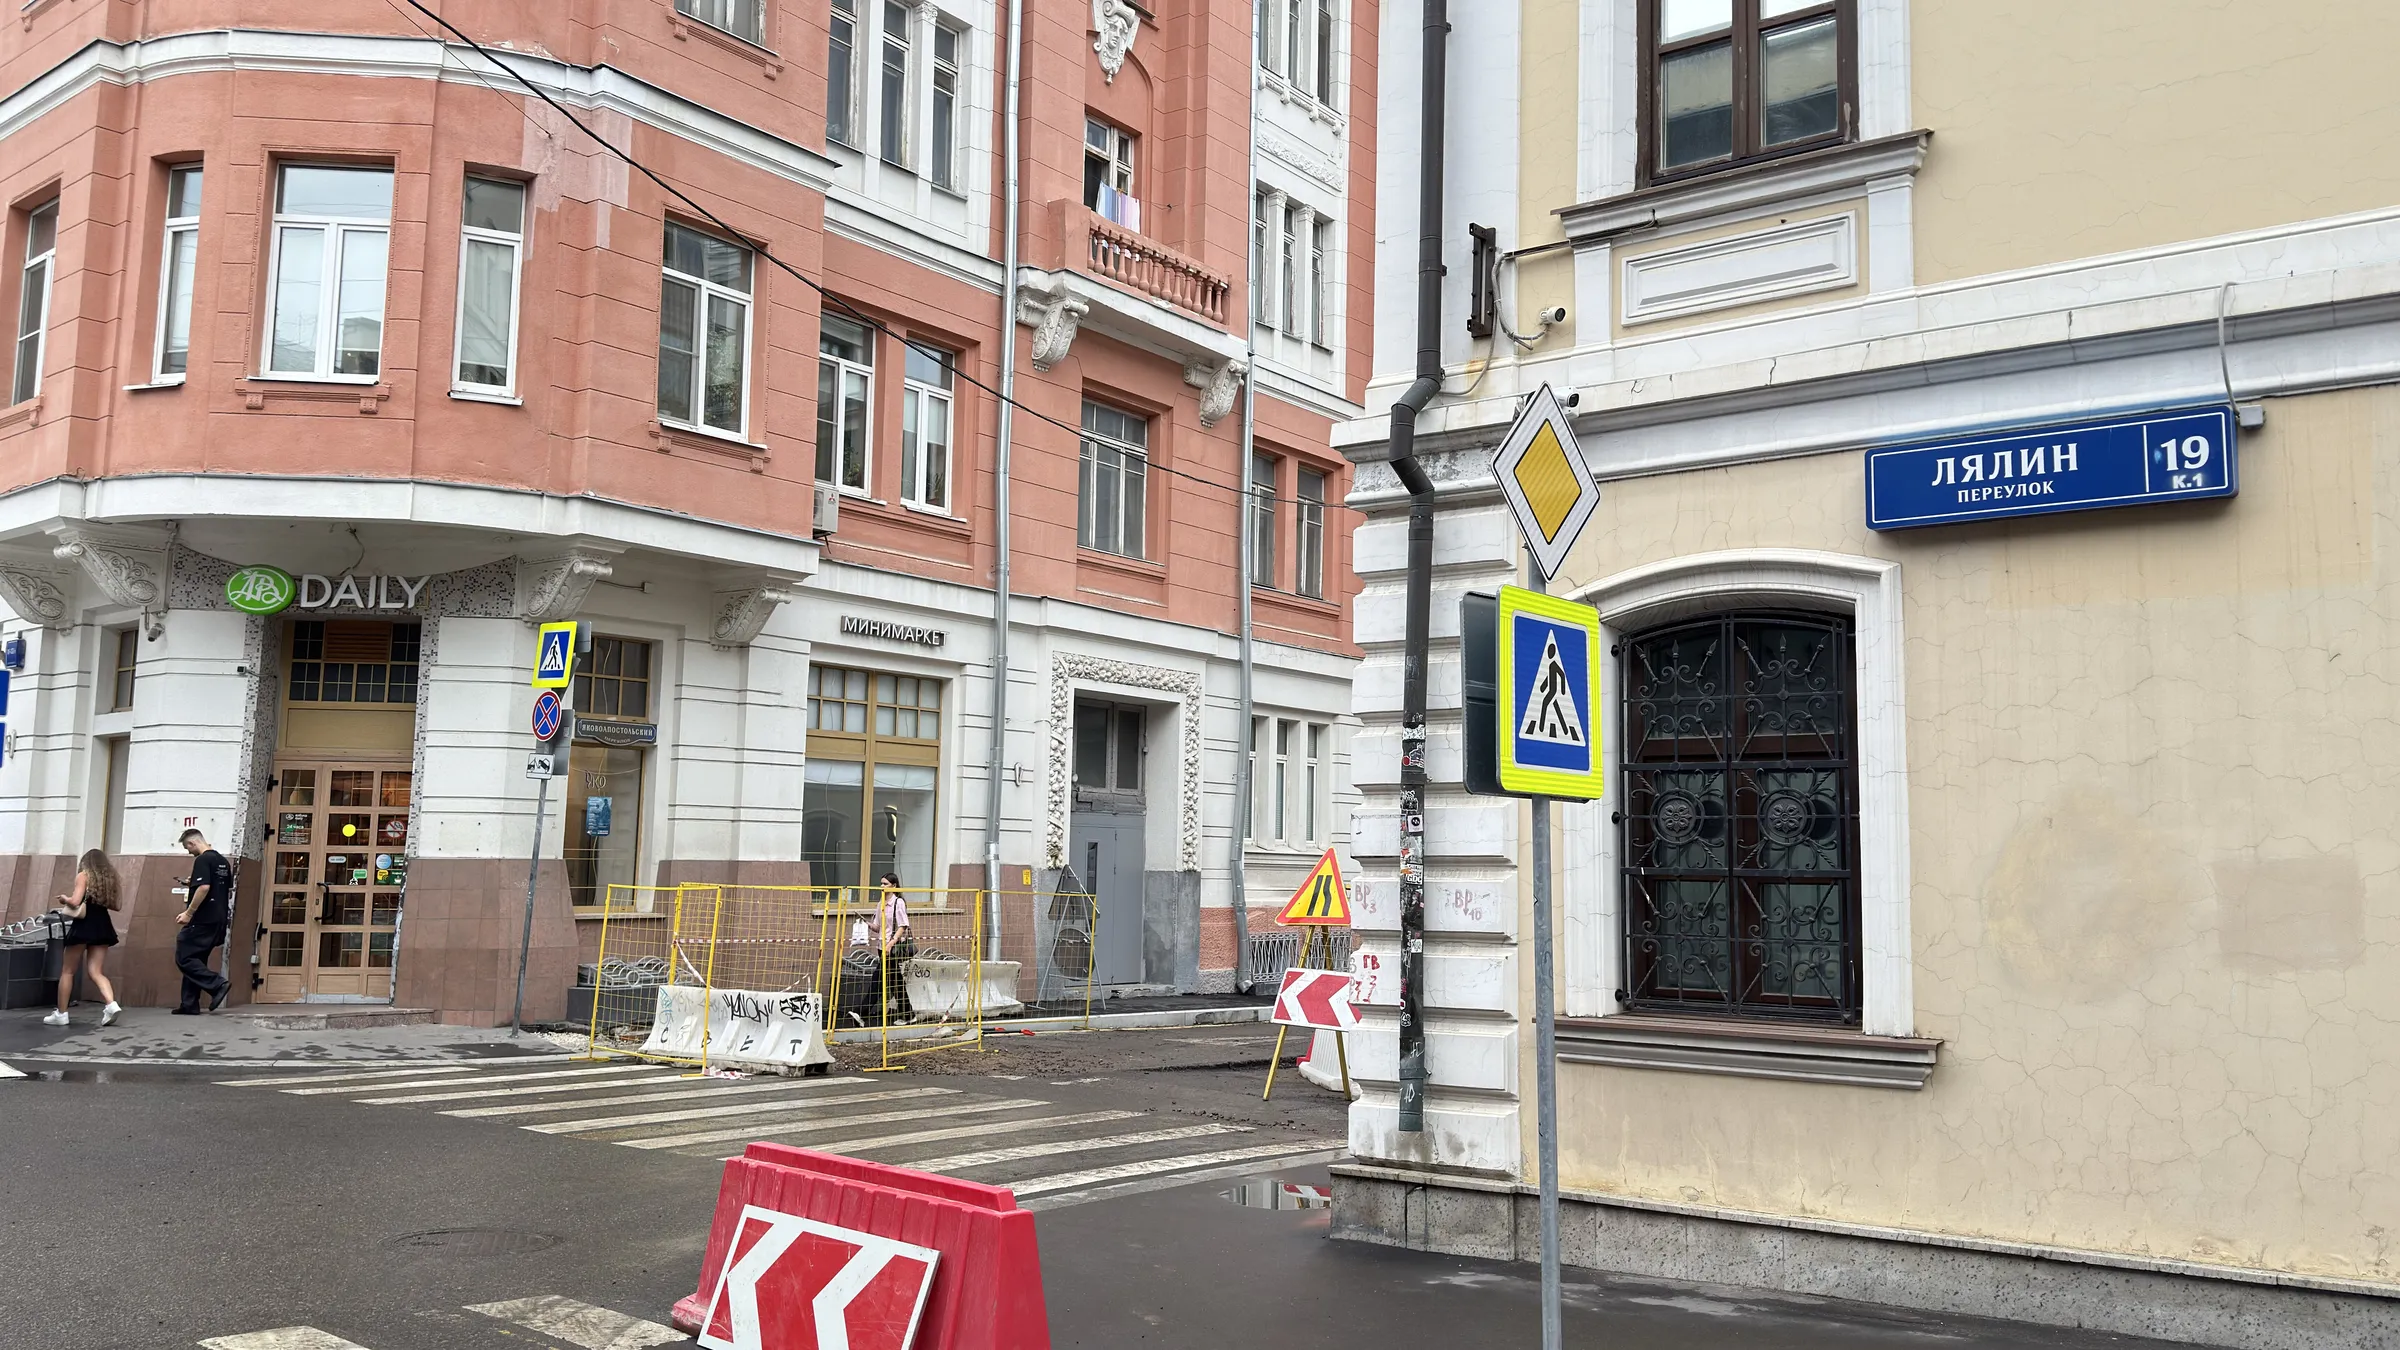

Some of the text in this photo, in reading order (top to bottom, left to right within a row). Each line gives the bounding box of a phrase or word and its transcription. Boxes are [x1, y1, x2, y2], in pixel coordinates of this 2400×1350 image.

[1931, 443, 2078, 487] ЛЯЛИН
[2160, 435, 2210, 471] 19
[1957, 480, 2055, 503] ПЕРЕУЛОК
[2172, 472, 2203, 489] К.1
[300, 574, 432, 609] DAILY
[842, 616, 950, 645] МИНИМАРКЕТ
[581, 724, 653, 737] ЯКОВОАПОСТОЛЬСКИЙ
